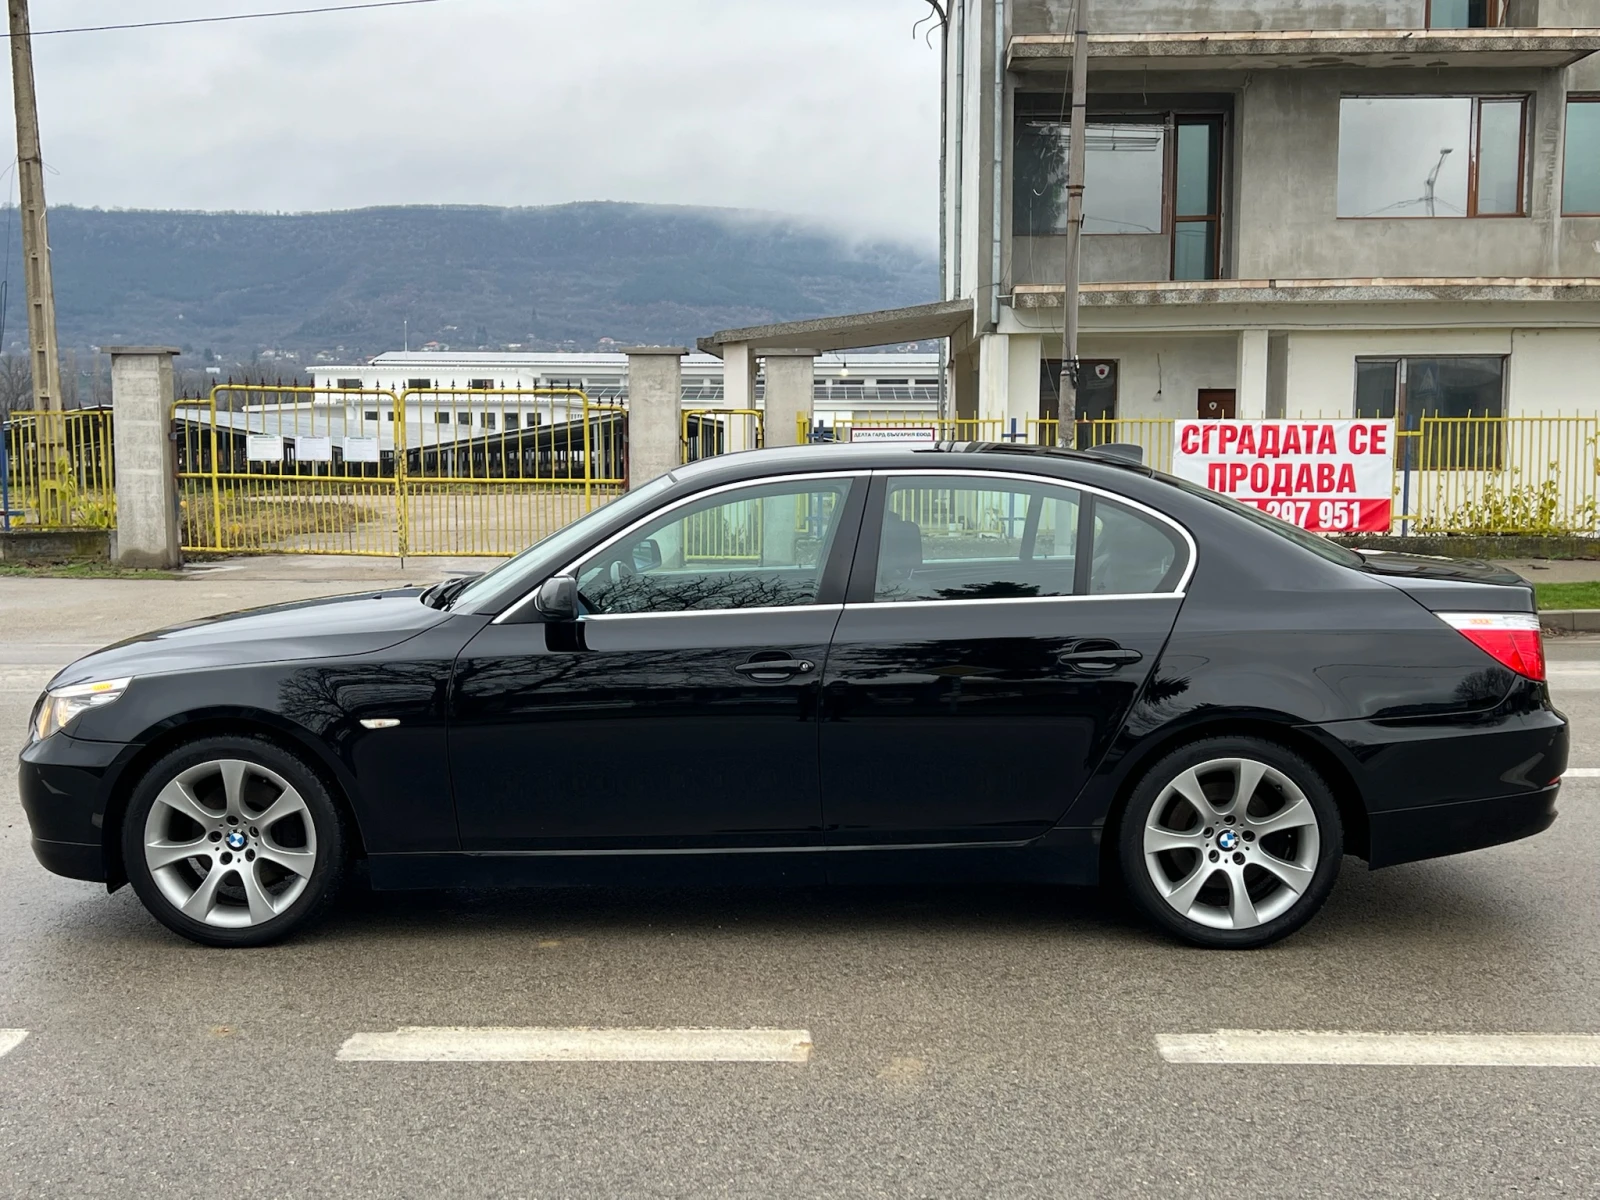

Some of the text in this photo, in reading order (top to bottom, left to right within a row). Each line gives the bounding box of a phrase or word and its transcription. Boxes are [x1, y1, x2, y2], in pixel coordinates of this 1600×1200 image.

[1181, 424, 1387, 458] СГРАДАТА СЕ
[1207, 463, 1357, 496] ПРОДАВА
[1318, 500, 1360, 529] 951
